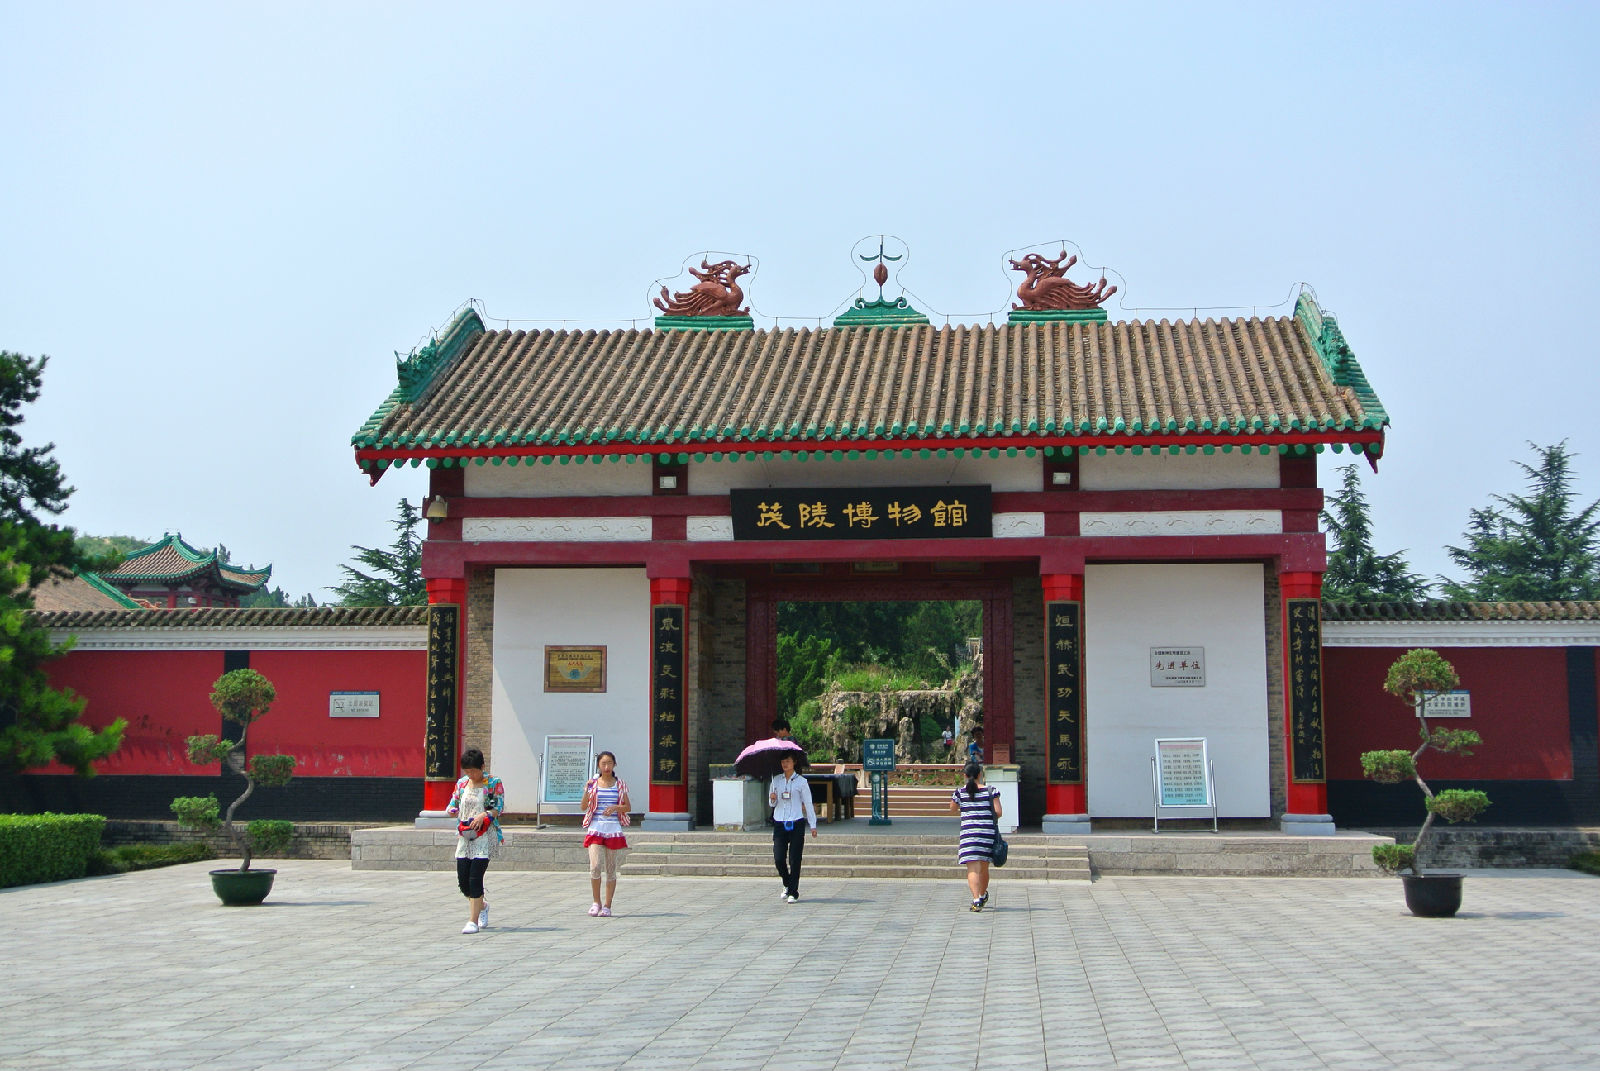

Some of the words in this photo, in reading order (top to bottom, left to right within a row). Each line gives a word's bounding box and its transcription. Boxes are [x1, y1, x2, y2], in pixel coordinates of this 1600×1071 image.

[756, 500, 968, 529] 茂陵博物館
